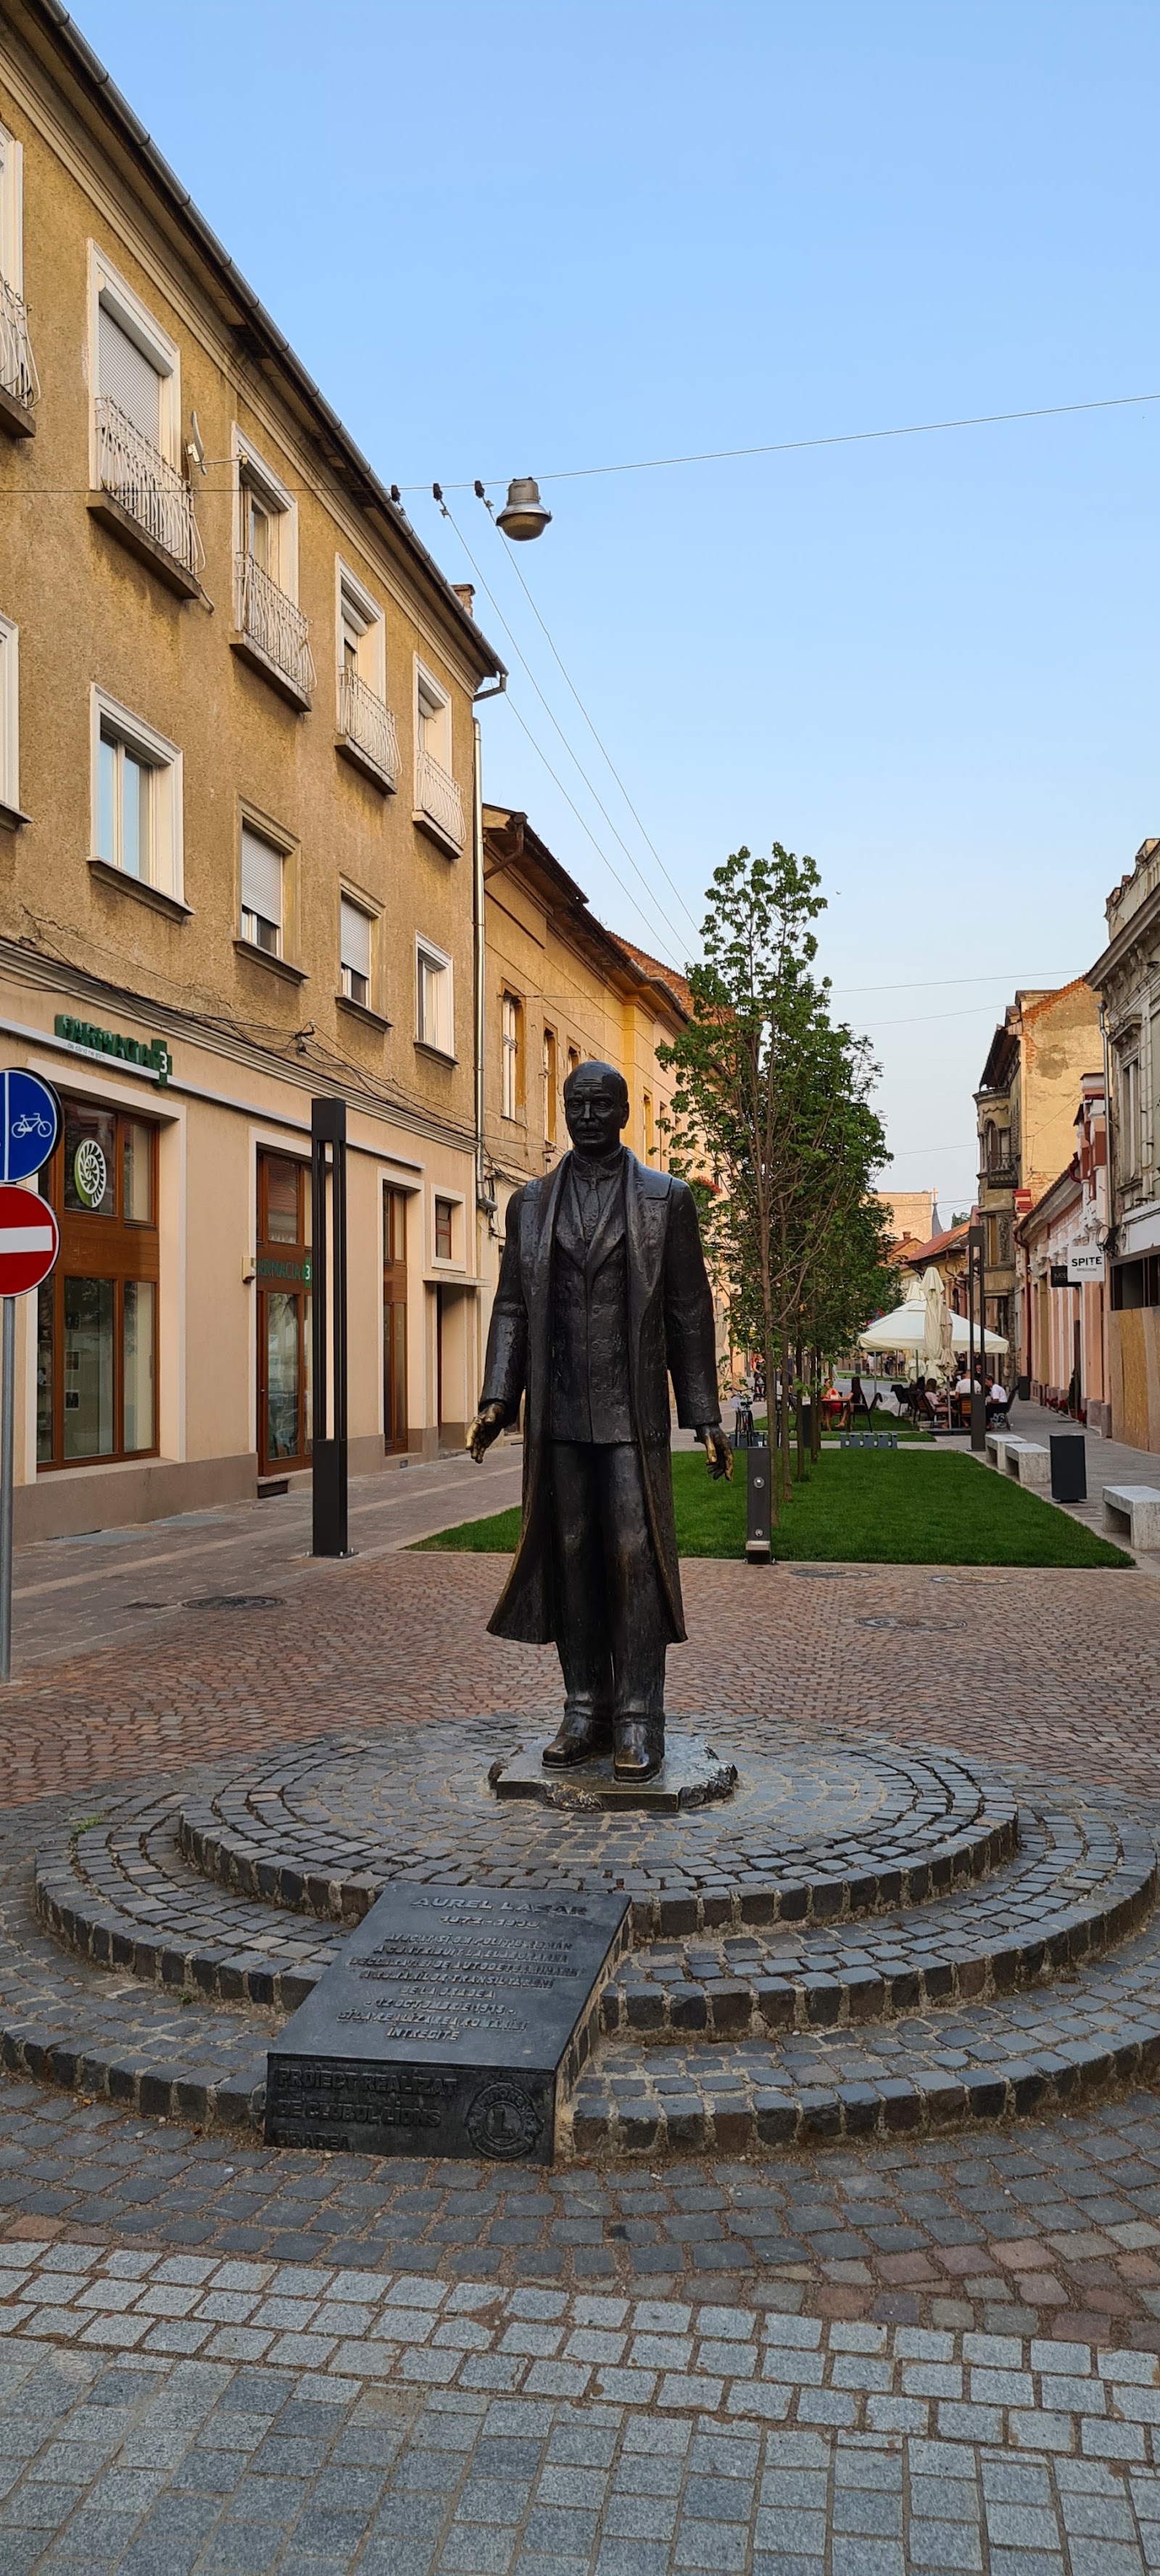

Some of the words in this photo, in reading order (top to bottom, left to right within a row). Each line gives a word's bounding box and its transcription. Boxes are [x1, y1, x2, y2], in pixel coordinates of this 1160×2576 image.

[54, 1014, 152, 1069] FARMACIA
[159, 1050, 167, 1073] 3
[305, 1264, 310, 1280] 3
[1072, 1256, 1102, 1267] SPITE
[411, 1897, 493, 1910] AUREL
[276, 2065, 358, 2090] PROIECT
[361, 2070, 458, 2096] REALIZAT
[276, 2099, 303, 2118] DE
[304, 2102, 381, 2123] CLUBUL
[381, 2100, 442, 2126] LIONS
